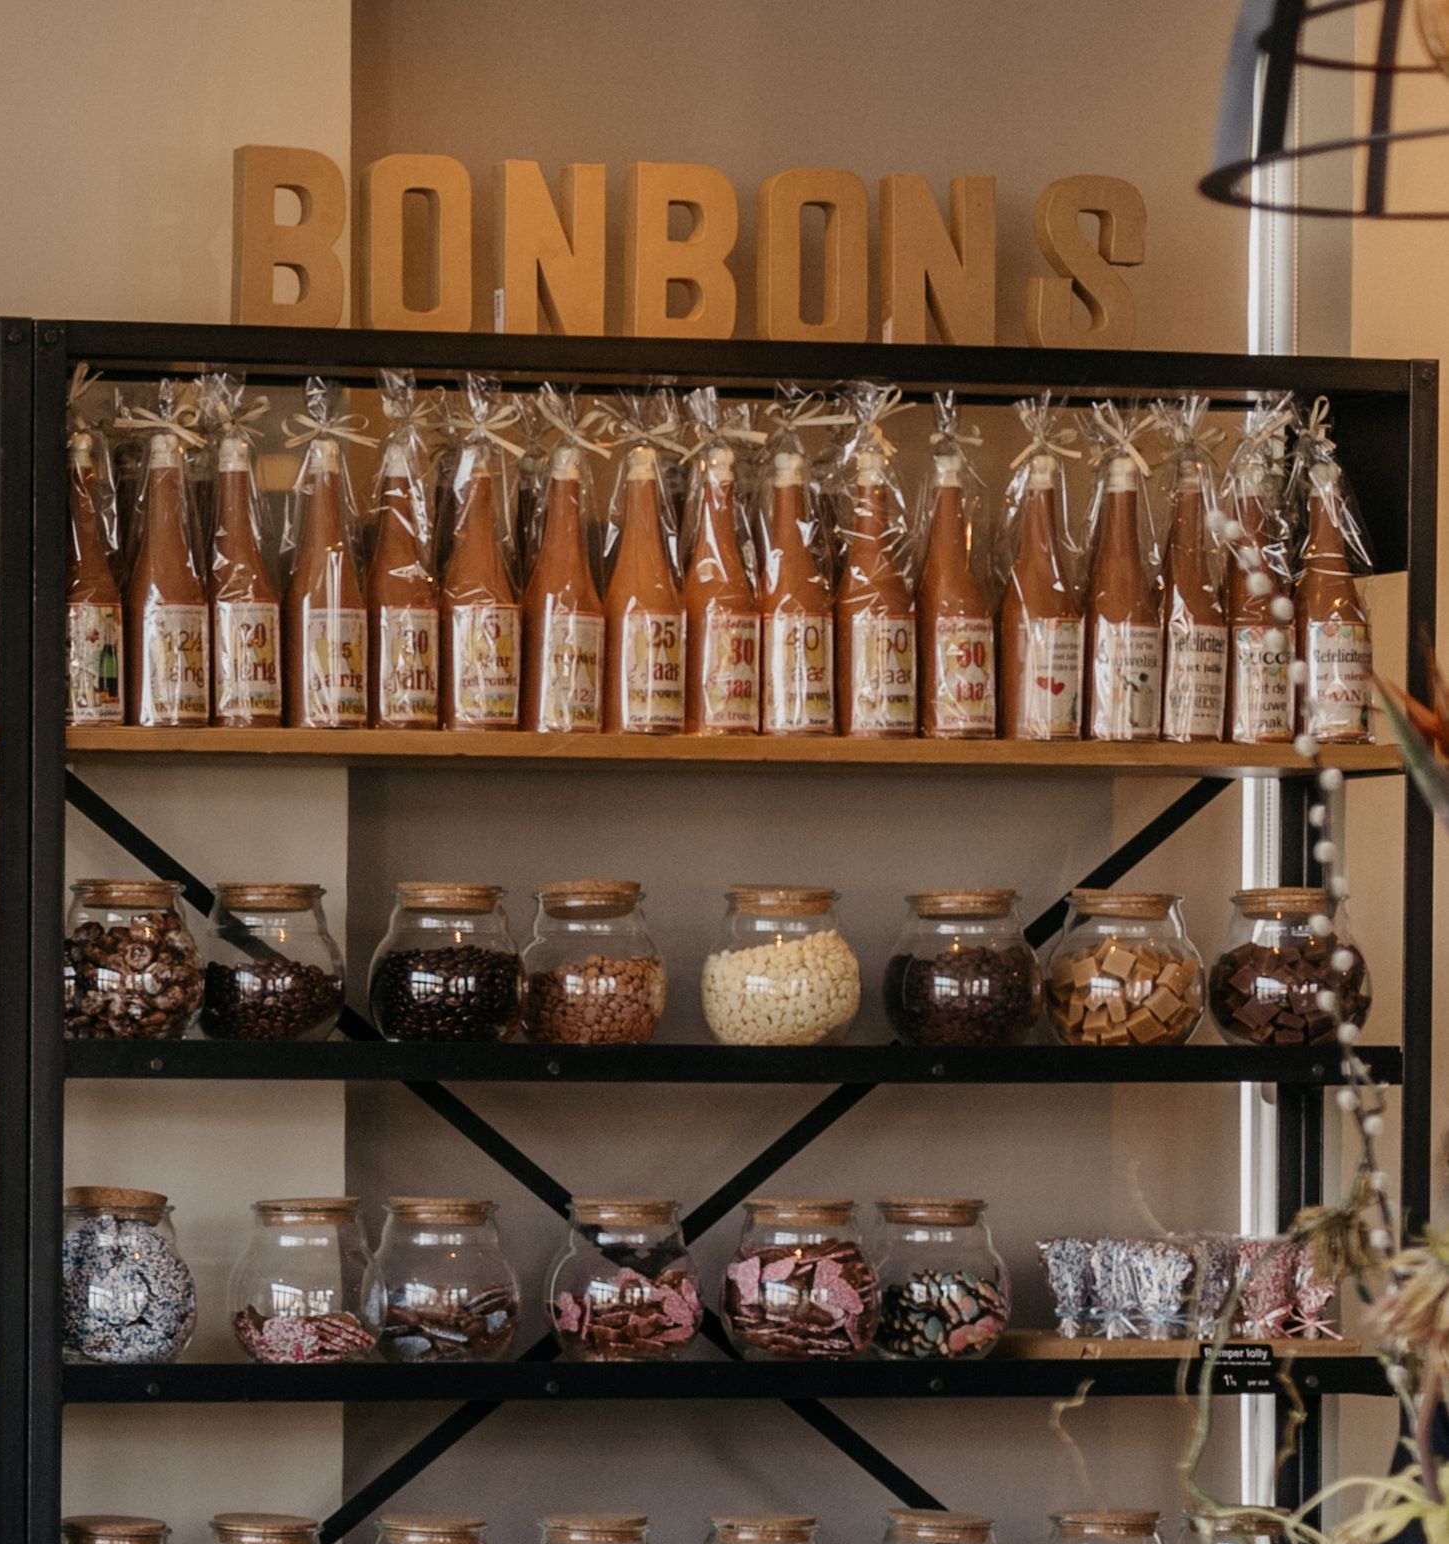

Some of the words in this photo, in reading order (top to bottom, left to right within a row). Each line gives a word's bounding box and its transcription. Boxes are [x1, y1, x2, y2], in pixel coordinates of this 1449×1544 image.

[233, 145, 1147, 348] BONBONS
[785, 625, 820, 651] 40
[730, 636, 755, 666] 30
[1238, 652, 1292, 666] SUCC
[1313, 650, 1372, 665] Gefelicitee
[168, 663, 205, 689] arig
[647, 662, 680, 682] aar
[724, 679, 753, 703] jaa
[955, 682, 985, 703] jaa
[1272, 682, 1287, 695] de
[1245, 1348, 1268, 1361] lolly
